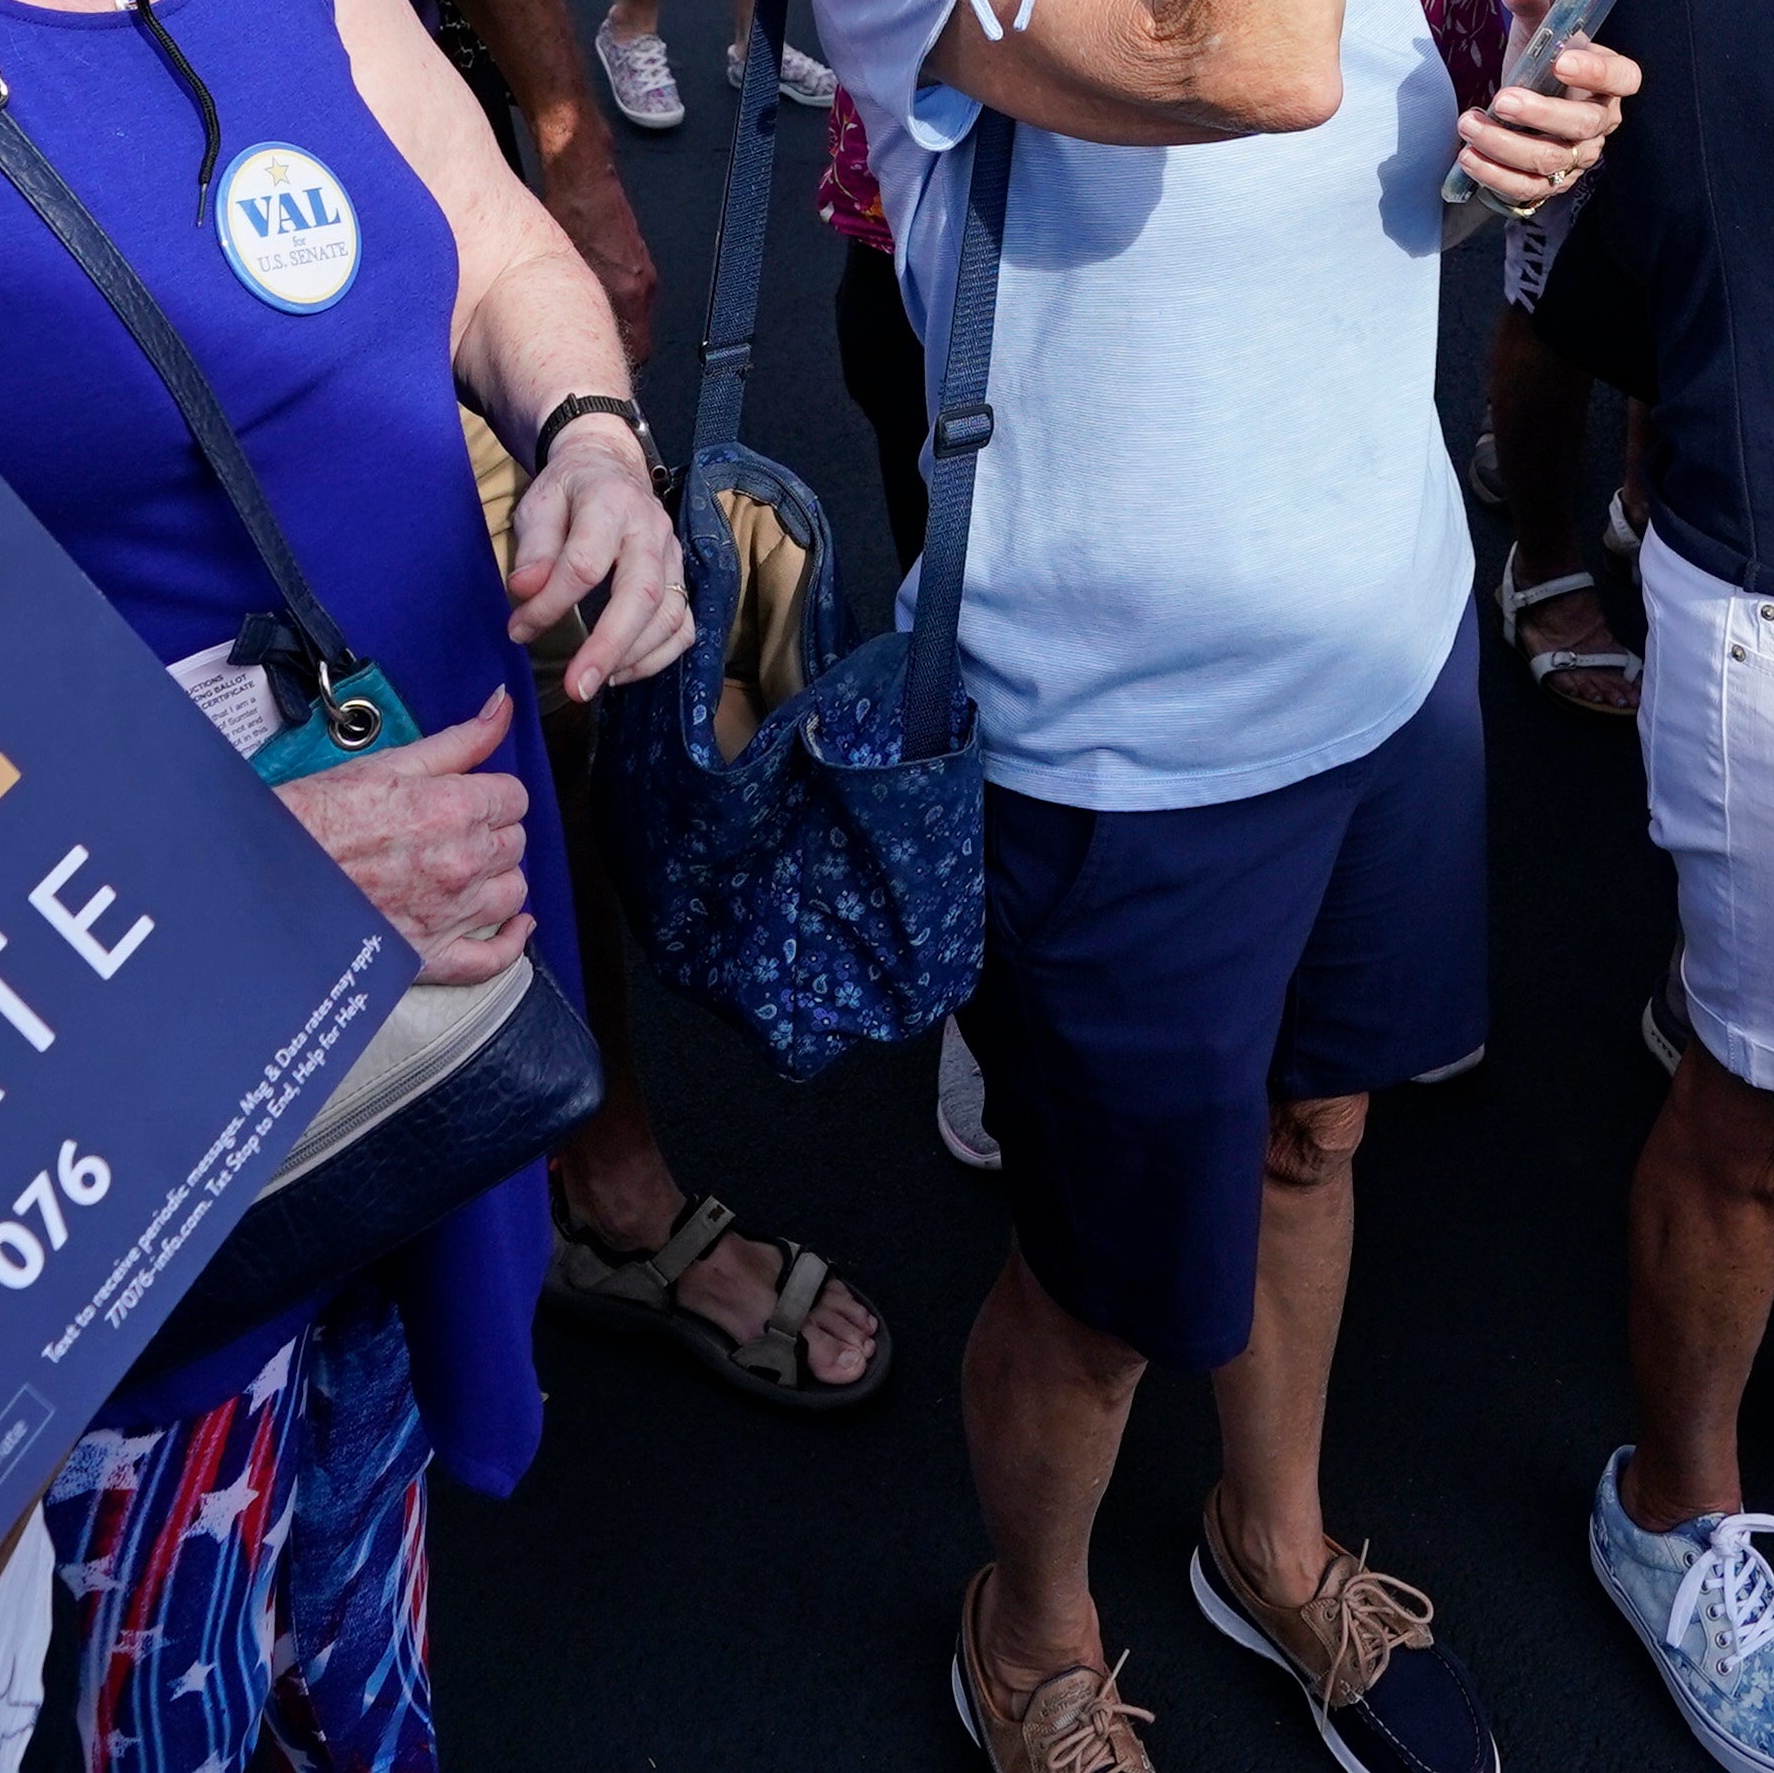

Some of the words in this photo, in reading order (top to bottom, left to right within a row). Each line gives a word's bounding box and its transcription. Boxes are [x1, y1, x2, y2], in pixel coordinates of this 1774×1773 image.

[235, 187, 341, 238] VAL
[257, 254, 288, 273] U.S.
[290, 241, 349, 267] SENATE
[292, 236, 306, 248] for
[202, 682, 254, 709] CERTIFICATE
[214, 674, 247, 692] BALLOT
[42, 1325, 80, 1362] Text
[75, 1305, 95, 1327] to
[93, 1247, 141, 1307] receive
[138, 1185, 189, 1253] periodic
[187, 1117, 245, 1187] messages.
[240, 1081, 274, 1115] Msg
[265, 1065, 281, 1082] &
[275, 1032, 307, 1067] Data
[305, 999, 333, 1033] rates
[330, 970, 355, 1000] may
[351, 936, 381, 972] apply.
[105, 1201, 212, 1328] 77076-info.com.
[205, 1170, 232, 1196] Txt
[226, 1135, 260, 1172] Stop
[256, 1117, 273, 1136] to
[267, 1083, 300, 1118] End,
[292, 1049, 325, 1084] Help
[319, 1026, 339, 1049] for
[335, 994, 367, 1028] Help.
